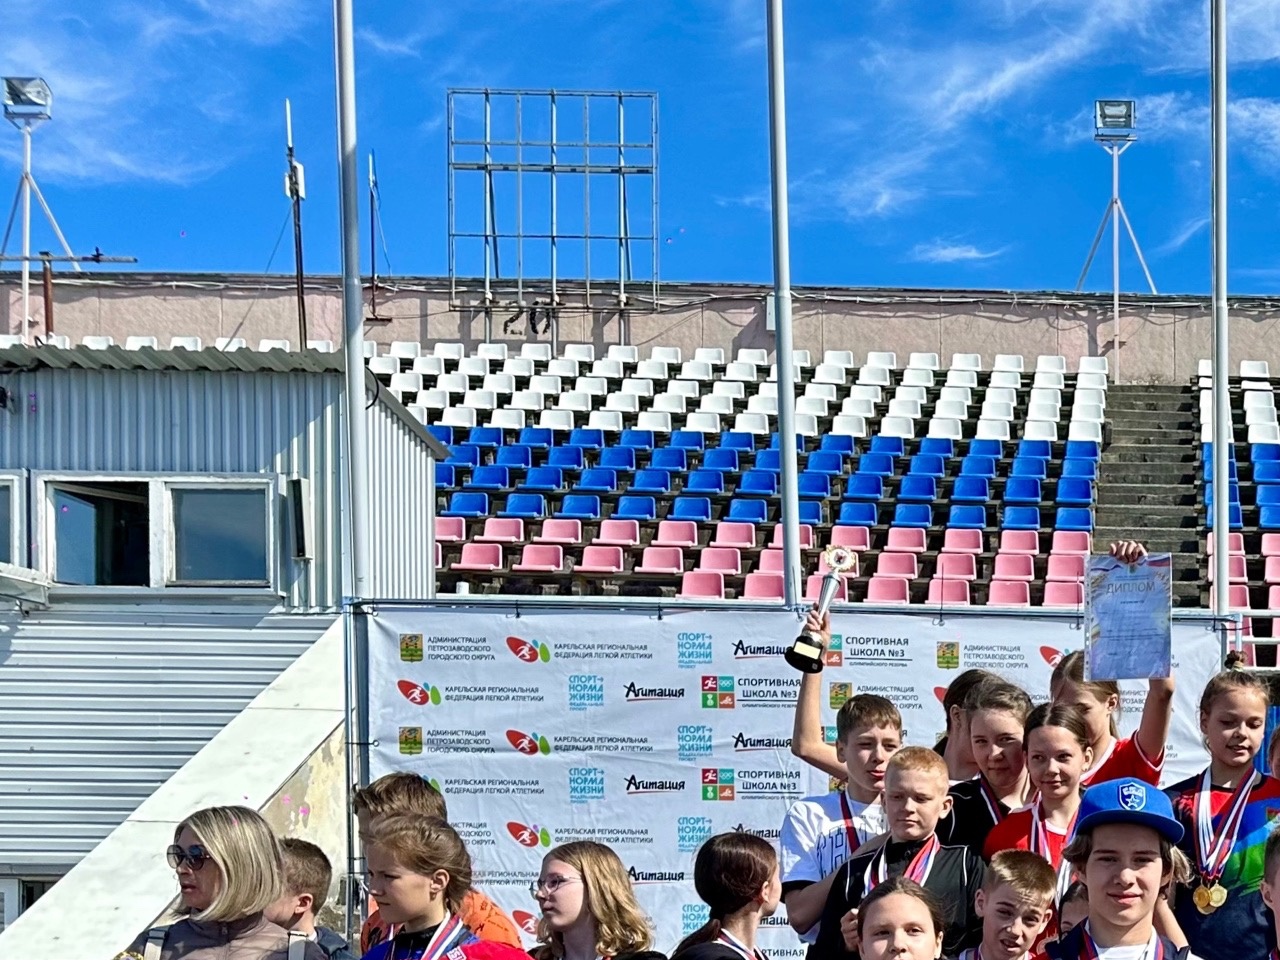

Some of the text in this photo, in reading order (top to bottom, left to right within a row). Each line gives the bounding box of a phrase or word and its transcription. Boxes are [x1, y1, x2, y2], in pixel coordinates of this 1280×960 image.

[1106, 581, 1156, 595] ДИПЛОМ
[846, 637, 909, 646] СПОРТИВНАЯ
[678, 642, 712, 650] НОРМА
[732, 640, 793, 656] Агитаци
[678, 651, 712, 659] ЖИЗНИ
[850, 648, 905, 657] ШКОЛА №3
[569, 675, 596, 683] СПОРТ
[738, 678, 801, 687] СПОРТИВНАЯ
[569, 684, 603, 692] НОРМА
[624, 682, 685, 698] Агитация
[743, 690, 797, 698] ШКОЛА №3
[678, 726, 705, 734] СПОРТ
[678, 744, 712, 752] ЖИЗНИ
[569, 768, 597, 776] СПОРТ
[738, 770, 801, 779] СПОРТИВНАЯ
[569, 777, 604, 785] НОРМА
[624, 775, 685, 790] Агитация
[569, 786, 604, 794] ЖИЗНИ
[742, 782, 797, 790] ШКОЛА №3
[678, 817, 705, 825] СПОРТ
[678, 826, 712, 834] НОРМА
